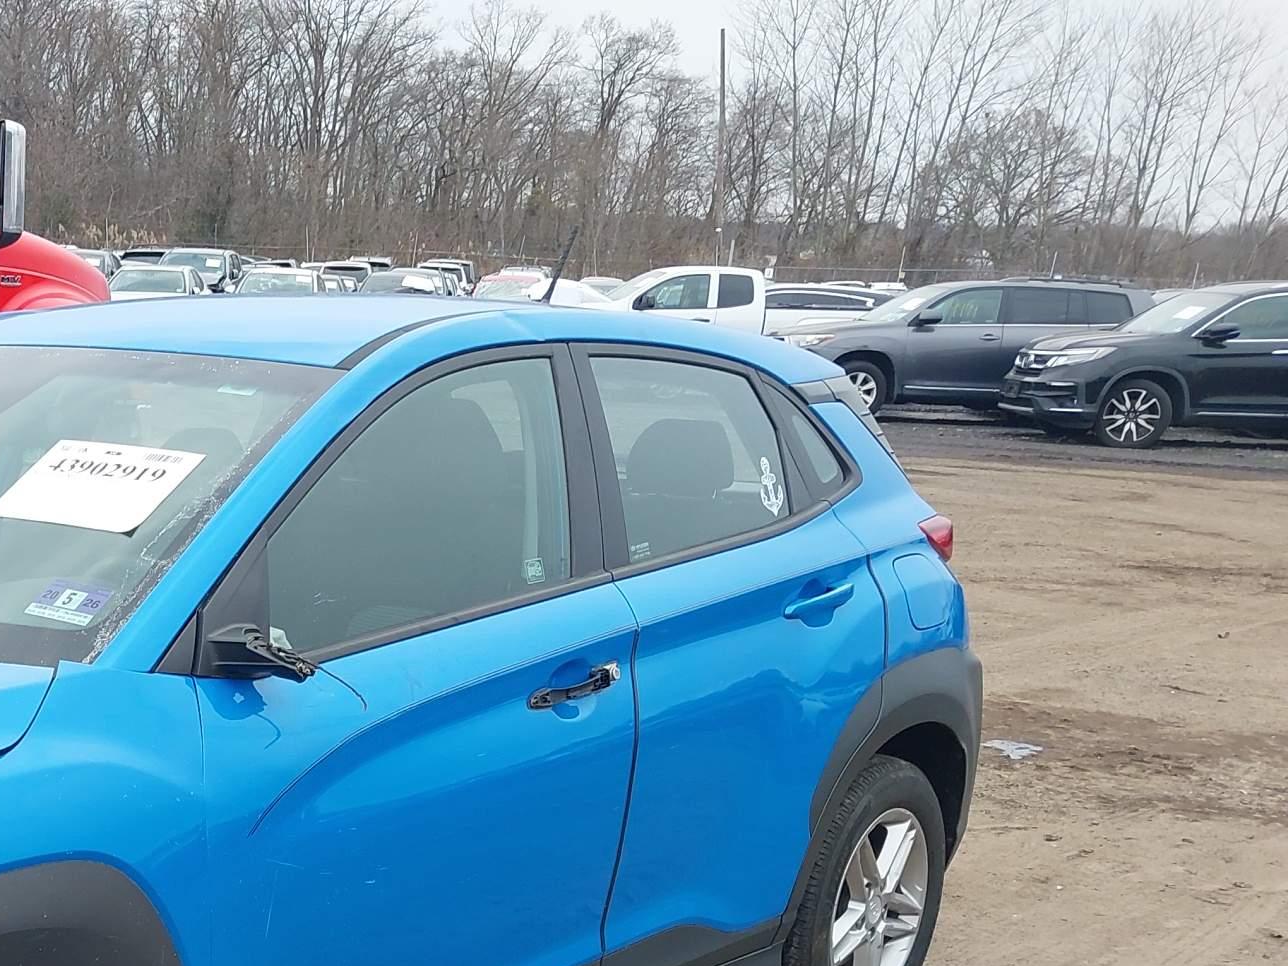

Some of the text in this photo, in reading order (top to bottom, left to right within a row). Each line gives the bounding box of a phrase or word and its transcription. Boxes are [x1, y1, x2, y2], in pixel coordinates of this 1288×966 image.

[48, 458, 167, 482] 43902919
[41, 589, 101, 609] 20 5 26
